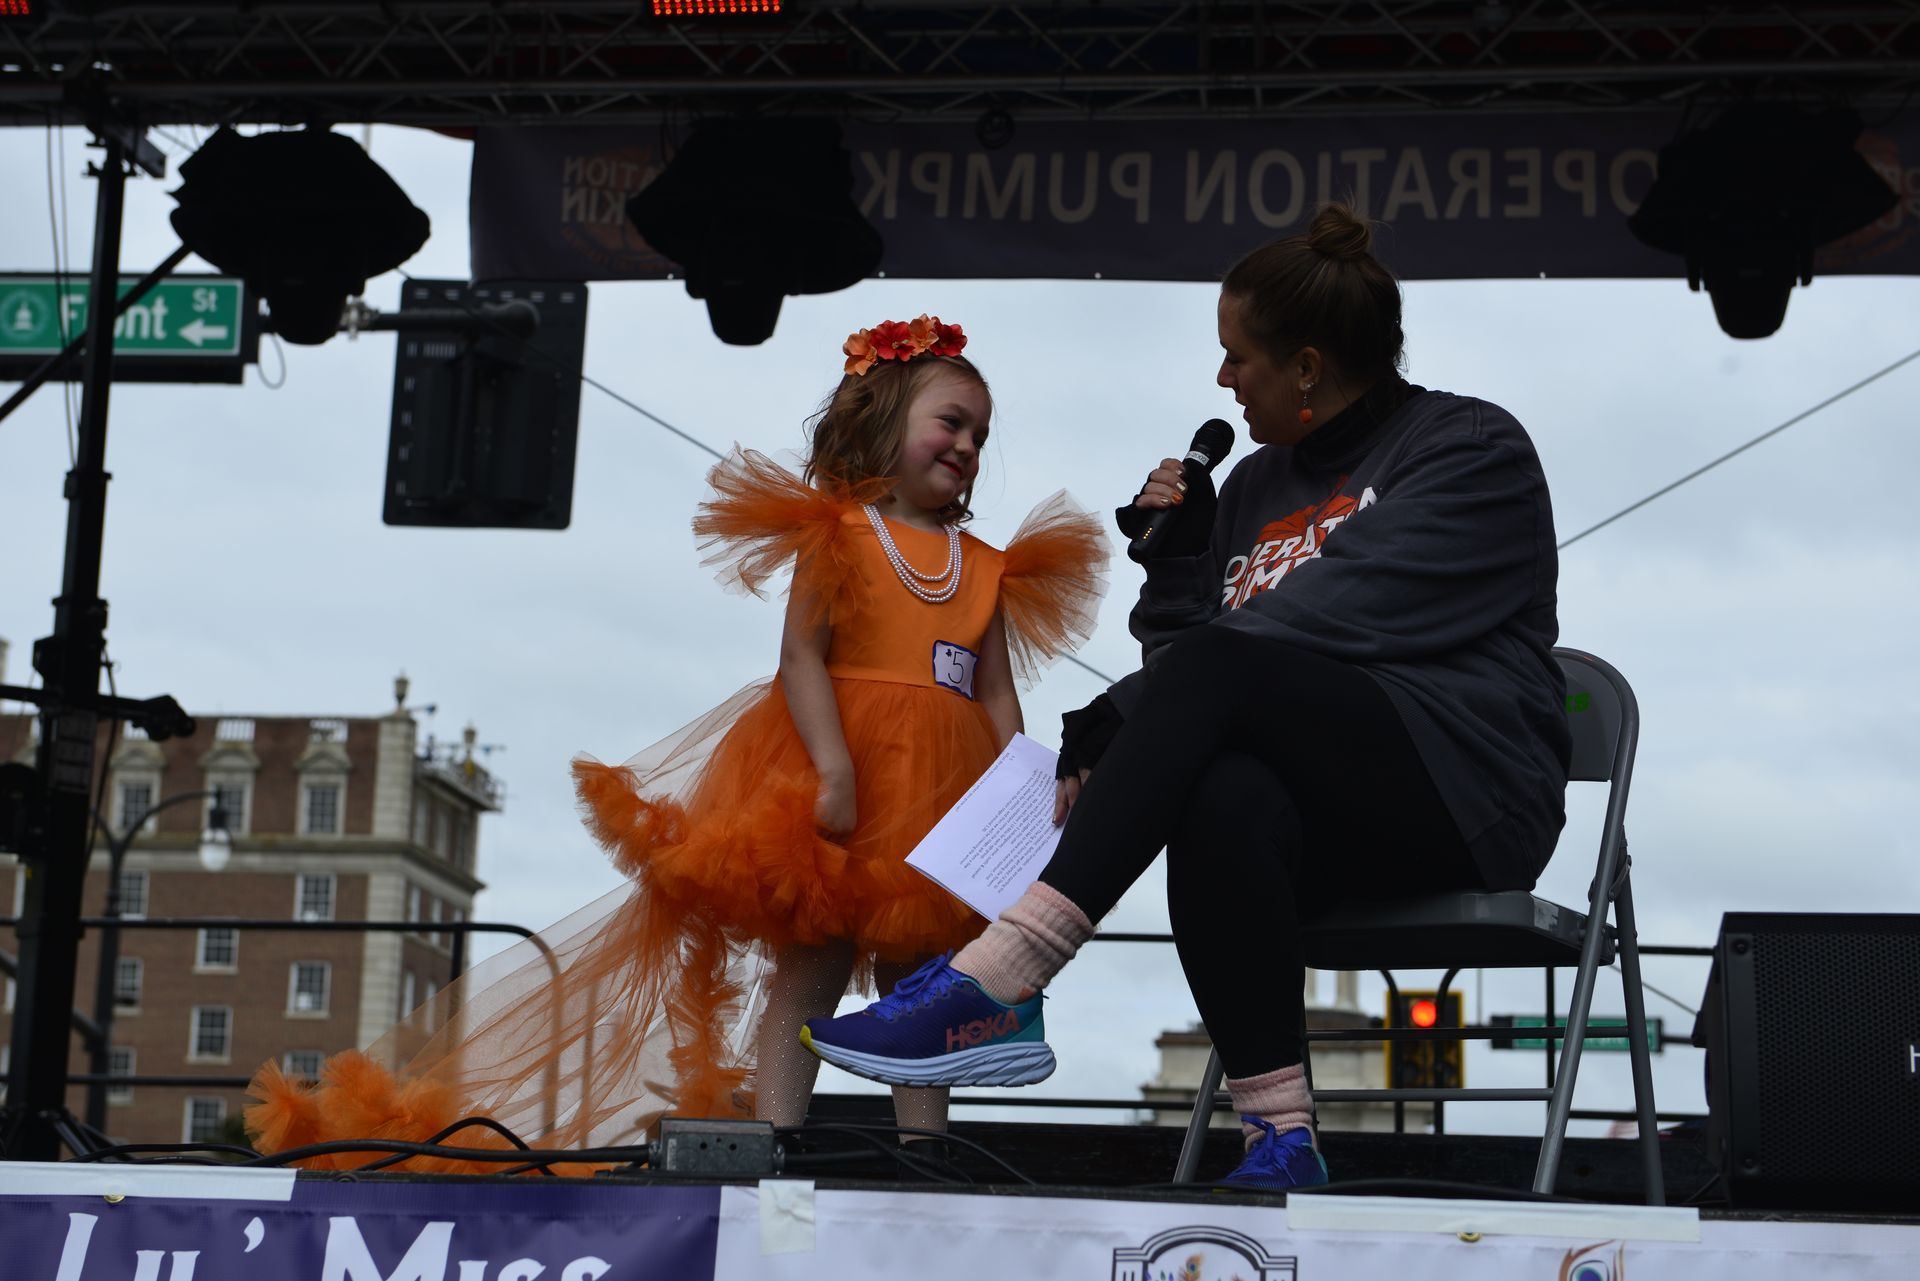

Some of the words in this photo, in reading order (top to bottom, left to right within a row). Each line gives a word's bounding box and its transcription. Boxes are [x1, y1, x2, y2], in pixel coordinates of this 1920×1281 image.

[60, 293, 169, 341] Fnt
[191, 287, 218, 313] St
[945, 1007, 1021, 1054] HOKA
